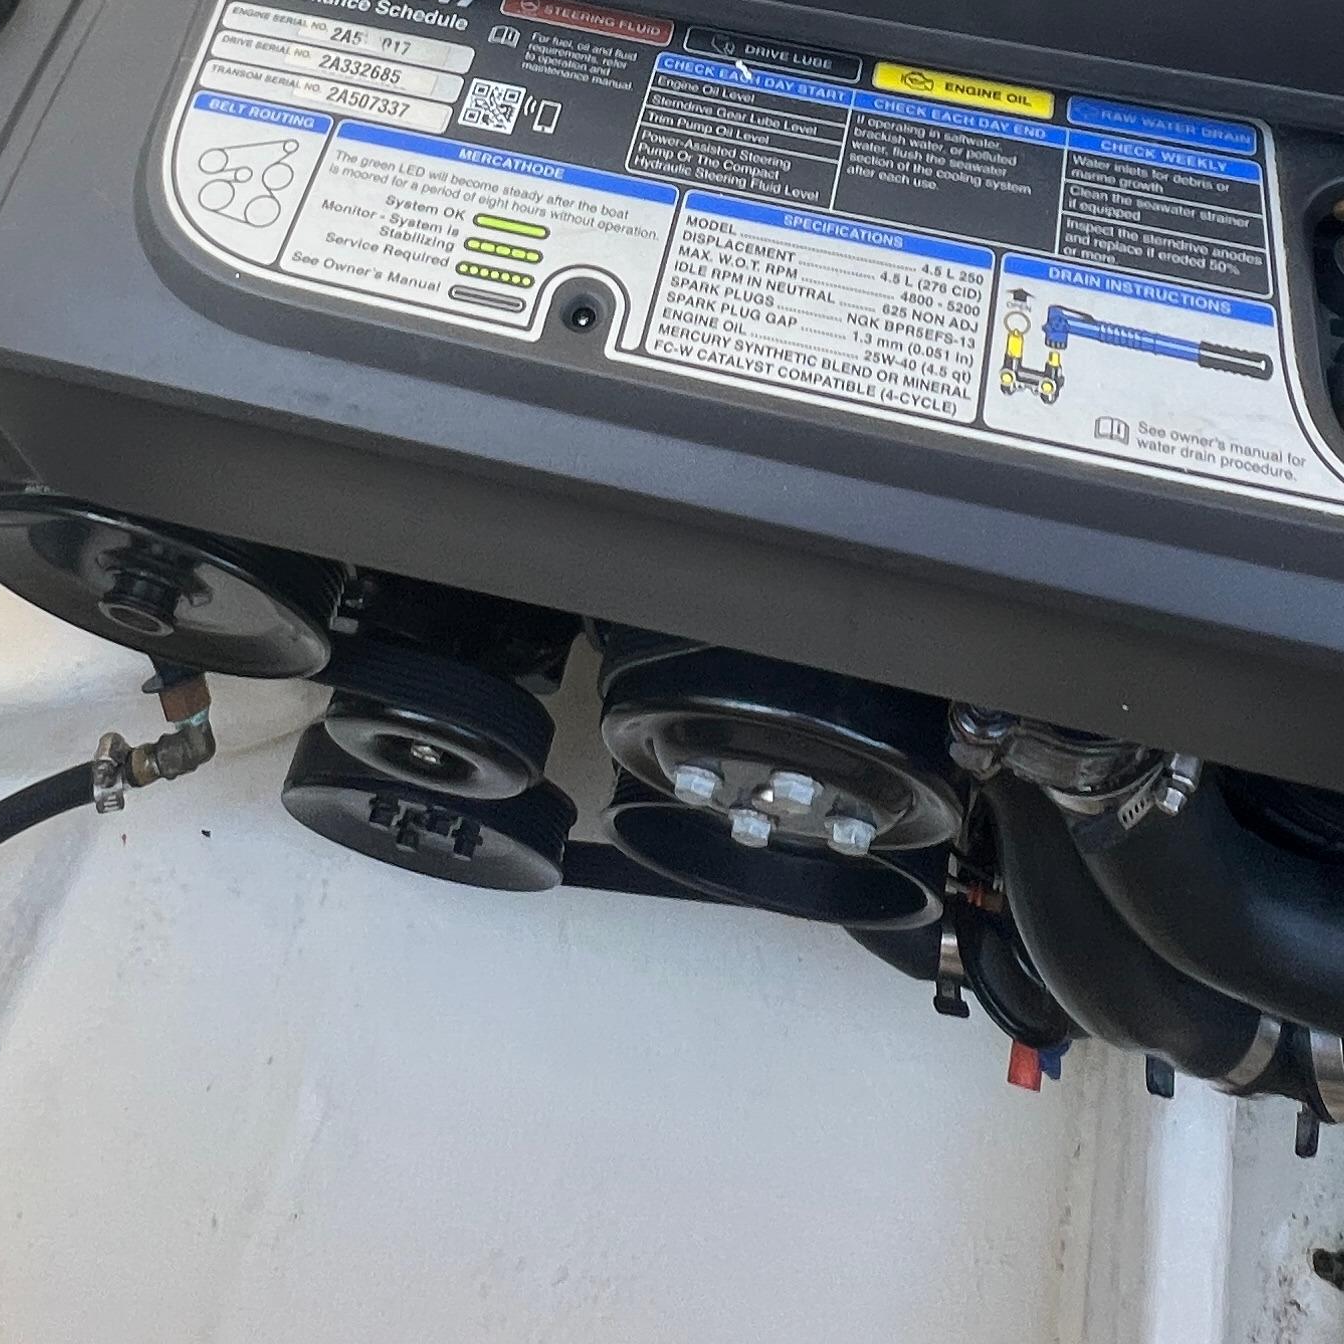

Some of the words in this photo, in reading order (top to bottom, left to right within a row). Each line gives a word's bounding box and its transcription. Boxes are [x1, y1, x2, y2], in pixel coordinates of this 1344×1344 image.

[543, 5, 616, 27] STEERING
[619, 19, 662, 36] FLUID
[319, 54, 403, 85] 2A332685
[744, 44, 789, 62] DRIVE
[793, 53, 833, 70] LUBE
[658, 75, 699, 94] Engine
[703, 83, 719, 95] Oil
[722, 86, 755, 103] Level
[664, 58, 714, 77] CHECK
[764, 77, 794, 91] DAY
[798, 83, 845, 101] START
[945, 82, 1002, 100] ENGINE
[1006, 93, 1032, 107] OIL
[209, 98, 246, 114] BELT
[249, 105, 315, 129] ROUTING
[326, 86, 411, 118] 2A507337
[651, 94, 714, 118] Sterndrive
[716, 106, 747, 122] Gear
[750, 112, 781, 129] Lube
[784, 119, 818, 136] Level
[874, 98, 927, 118] CHECK
[932, 106, 975, 126] EACH
[979, 116, 1010, 131] DAY
[1013, 122, 1046, 139] END
[647, 111, 674, 127] Trim
[676, 116, 713, 135] Pump
[715, 124, 733, 137] Oil
[736, 129, 770, 145] Level
[1102, 110, 1136, 125] RAW
[1142, 118, 1196, 136] WATER
[1201, 128, 1251, 145] DRAIN
[458, 148, 565, 180] MERCATHODE
[638, 142, 674, 161] Pump
[677, 149, 693, 162] Or
[697, 154, 720, 169] The
[723, 159, 780, 182] Compact
[641, 130, 737, 159] Power-Assisted
[739, 149, 792, 172] Steering
[1100, 139, 1155, 160] CHECK
[1161, 151, 1228, 173] WEEKLY
[337, 150, 357, 163] The
[361, 156, 395, 172] green
[398, 163, 426, 178] LED
[428, 170, 449, 182] will
[450, 174, 500, 193] become
[503, 187, 544, 205] steady
[546, 195, 576, 208] after
[578, 200, 598, 214] the
[600, 204, 629, 221] boat
[634, 154, 692, 178] Hydraulic
[695, 168, 747, 190] Steering
[750, 177, 782, 195] Fluid
[784, 185, 819, 201] Level
[321, 199, 376, 220] Monitor
[389, 212, 443, 234] System
[447, 225, 460, 237] is
[329, 163, 337, 173] is
[342, 166, 387, 185] moored
[390, 175, 409, 189] for
[410, 181, 418, 190] a
[421, 182, 462, 200] period
[463, 191, 476, 202] of
[478, 196, 509, 209] eight
[511, 203, 546, 217] hours
[550, 209, 595, 227] without
[597, 220, 660, 241] operation.
[385, 194, 439, 216] System
[443, 206, 467, 221] OK
[325, 232, 379, 253] Service
[383, 243, 450, 268] Required
[379, 225, 455, 253] Stabilizing
[686, 215, 737, 236] MODEL
[921, 263, 942, 276] 4.5
[946, 269, 955, 279] L
[958, 271, 984, 286] 250
[783, 215, 904, 249] SPECIFICATIONS
[292, 251, 320, 266] See
[323, 258, 382, 280] Owner's
[387, 270, 442, 292] Manual
[678, 245, 714, 263] MAX.
[719, 253, 760, 272] W.O.T.
[765, 263, 798, 280] RPM
[900, 291, 934, 307] 4800
[947, 300, 980, 317] 5200
[682, 230, 796, 263] DISPLACEMENT
[879, 271, 901, 285] 4.5
[905, 276, 914, 288] L
[917, 278, 948, 295] (276
[951, 285, 982, 303] CID)
[674, 260, 707, 276] IDLE
[711, 268, 744, 284] RPM
[747, 275, 762, 287] IN
[765, 279, 836, 305] NEUTRAL
[882, 304, 907, 318] 625
[912, 309, 946, 327] NON
[948, 318, 979, 334] ADJ
[1048, 266, 1102, 287] DRAIN
[1106, 276, 1232, 314] INSTRUCTIONS
[666, 291, 716, 312] SPARK
[720, 302, 761, 322] PLUG
[765, 311, 798, 328] GAP
[852, 330, 873, 345] 1.3
[877, 338, 903, 351] mm
[907, 342, 950, 363] (0.051
[955, 351, 974, 368] in)
[670, 275, 719, 297] SPARK
[724, 287, 775, 307] PLUGS
[847, 312, 880, 330] NGK
[884, 320, 976, 349] BPR5EFS-13
[658, 323, 731, 349] MERCURY
[734, 338, 818, 367] SYNTHETIC
[821, 358, 873, 378] BLEND
[876, 369, 899, 383] OR
[903, 375, 972, 400] MINERAL
[662, 307, 719, 328] ENGINE
[722, 320, 747, 335] OIL
[864, 349, 916, 371] 25W-40
[921, 361, 948, 378] (4.5
[951, 368, 972, 385] qt)
[654, 339, 693, 358] FC-W
[697, 349, 775, 375] CATALYST
[777, 365, 876, 397] COMPATIBLE
[880, 388, 958, 416] (4-CYCLE)
[1135, 439, 1175, 456] water
[1179, 446, 1216, 464] drain
[1220, 456, 1297, 482] procedure.
[1138, 420, 1166, 439] See
[1169, 428, 1226, 451] owner's
[1229, 440, 1284, 462] manual
[1287, 453, 1307, 468] for
